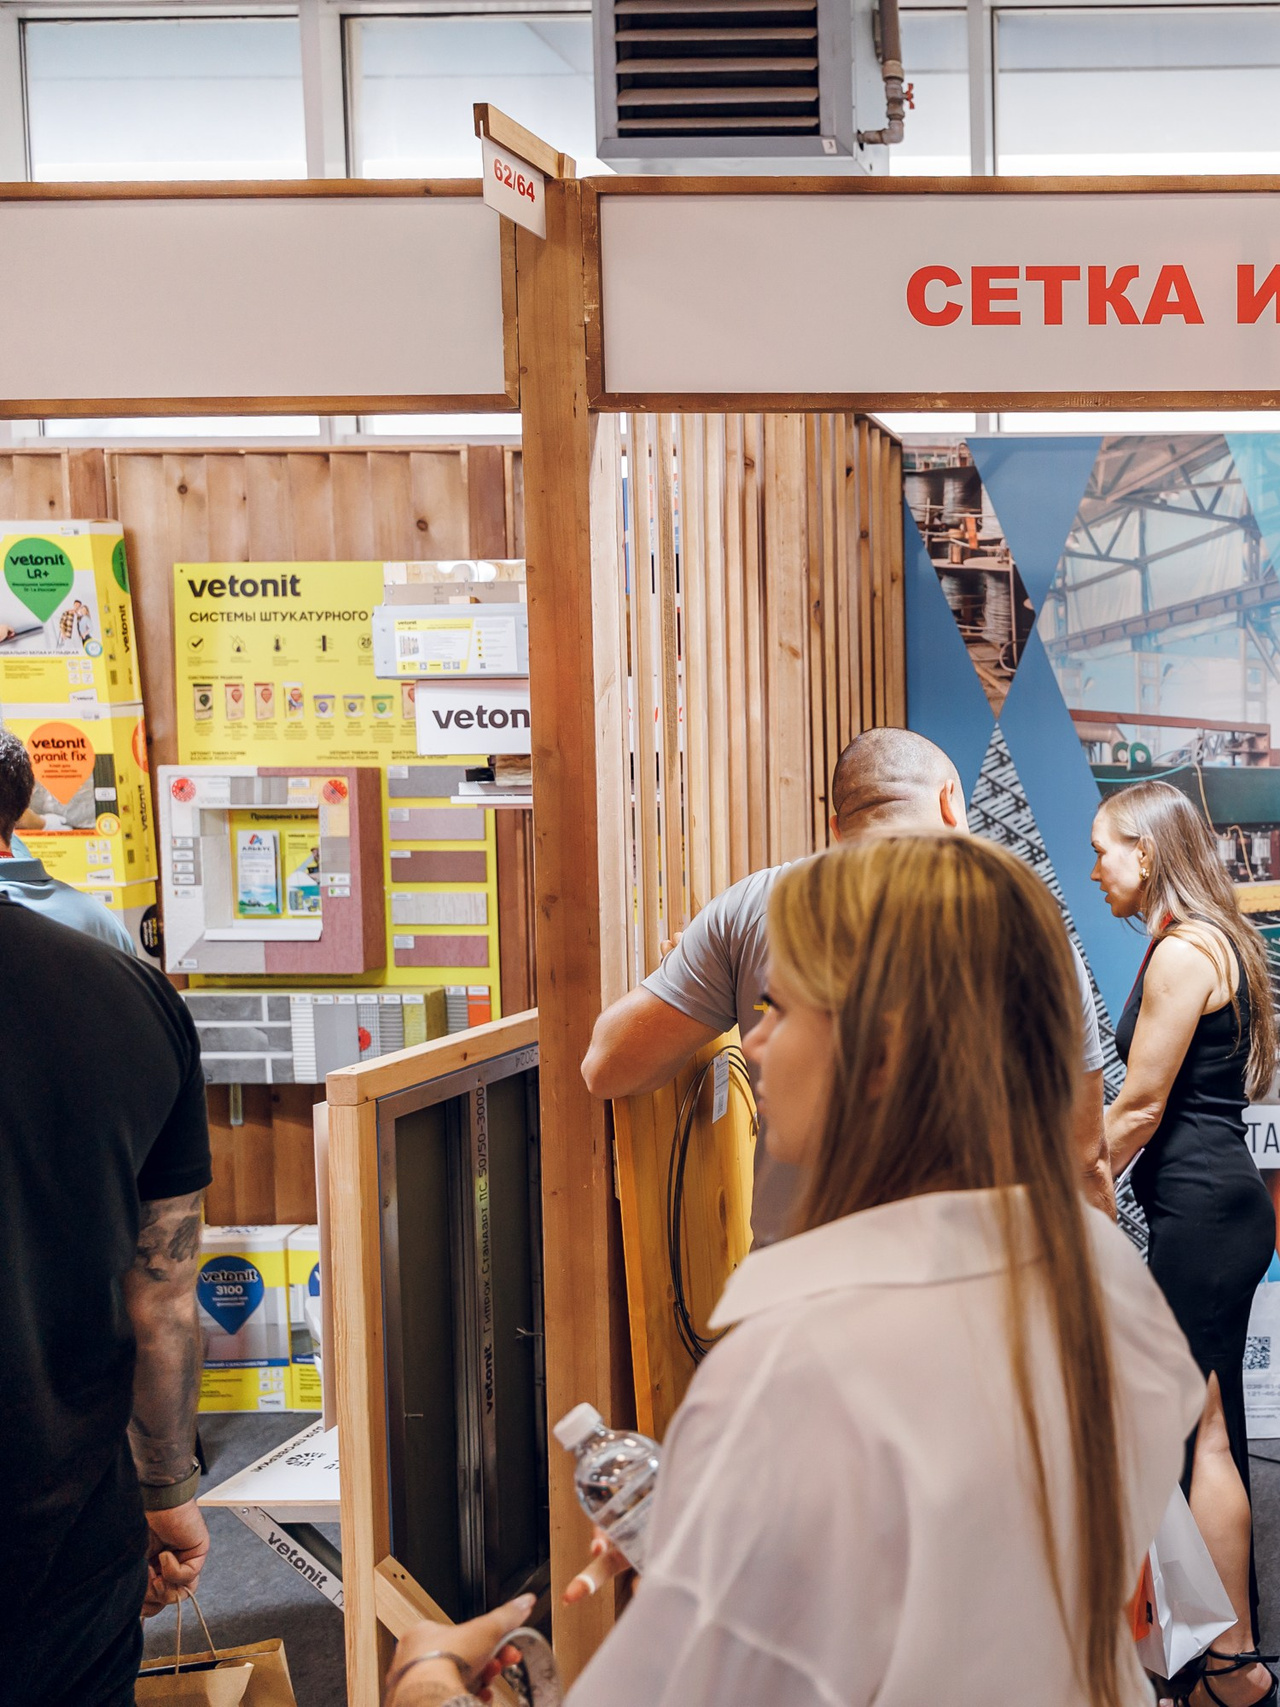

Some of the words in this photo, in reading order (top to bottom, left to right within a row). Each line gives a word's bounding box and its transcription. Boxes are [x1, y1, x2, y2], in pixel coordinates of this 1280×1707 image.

[494, 158, 536, 202] 62/64
[906, 263, 1205, 327] СЕТКА
[9, 554, 66, 566] vetonit
[26, 568, 50, 579] LR+
[187, 574, 302, 598] vetonit
[189, 611, 256, 623] СИСТЕМЫ
[260, 610, 369, 622] ШТУКАТУРНОГО
[432, 705, 531, 729] veton
[32, 737, 86, 749] vetonit
[33, 751, 68, 764] granit
[71, 751, 87, 761] fix
[475, 1086, 488, 1179] 50/50-3000
[477, 1182, 489, 1203] ПС
[480, 1207, 491, 1275] Стандарт
[200, 1269, 258, 1283] vetonit
[215, 1284, 244, 1296] 3100
[482, 1278, 492, 1334] Гипрок
[483, 1342, 495, 1415] vetonit
[267, 1531, 328, 1590] vetonit
